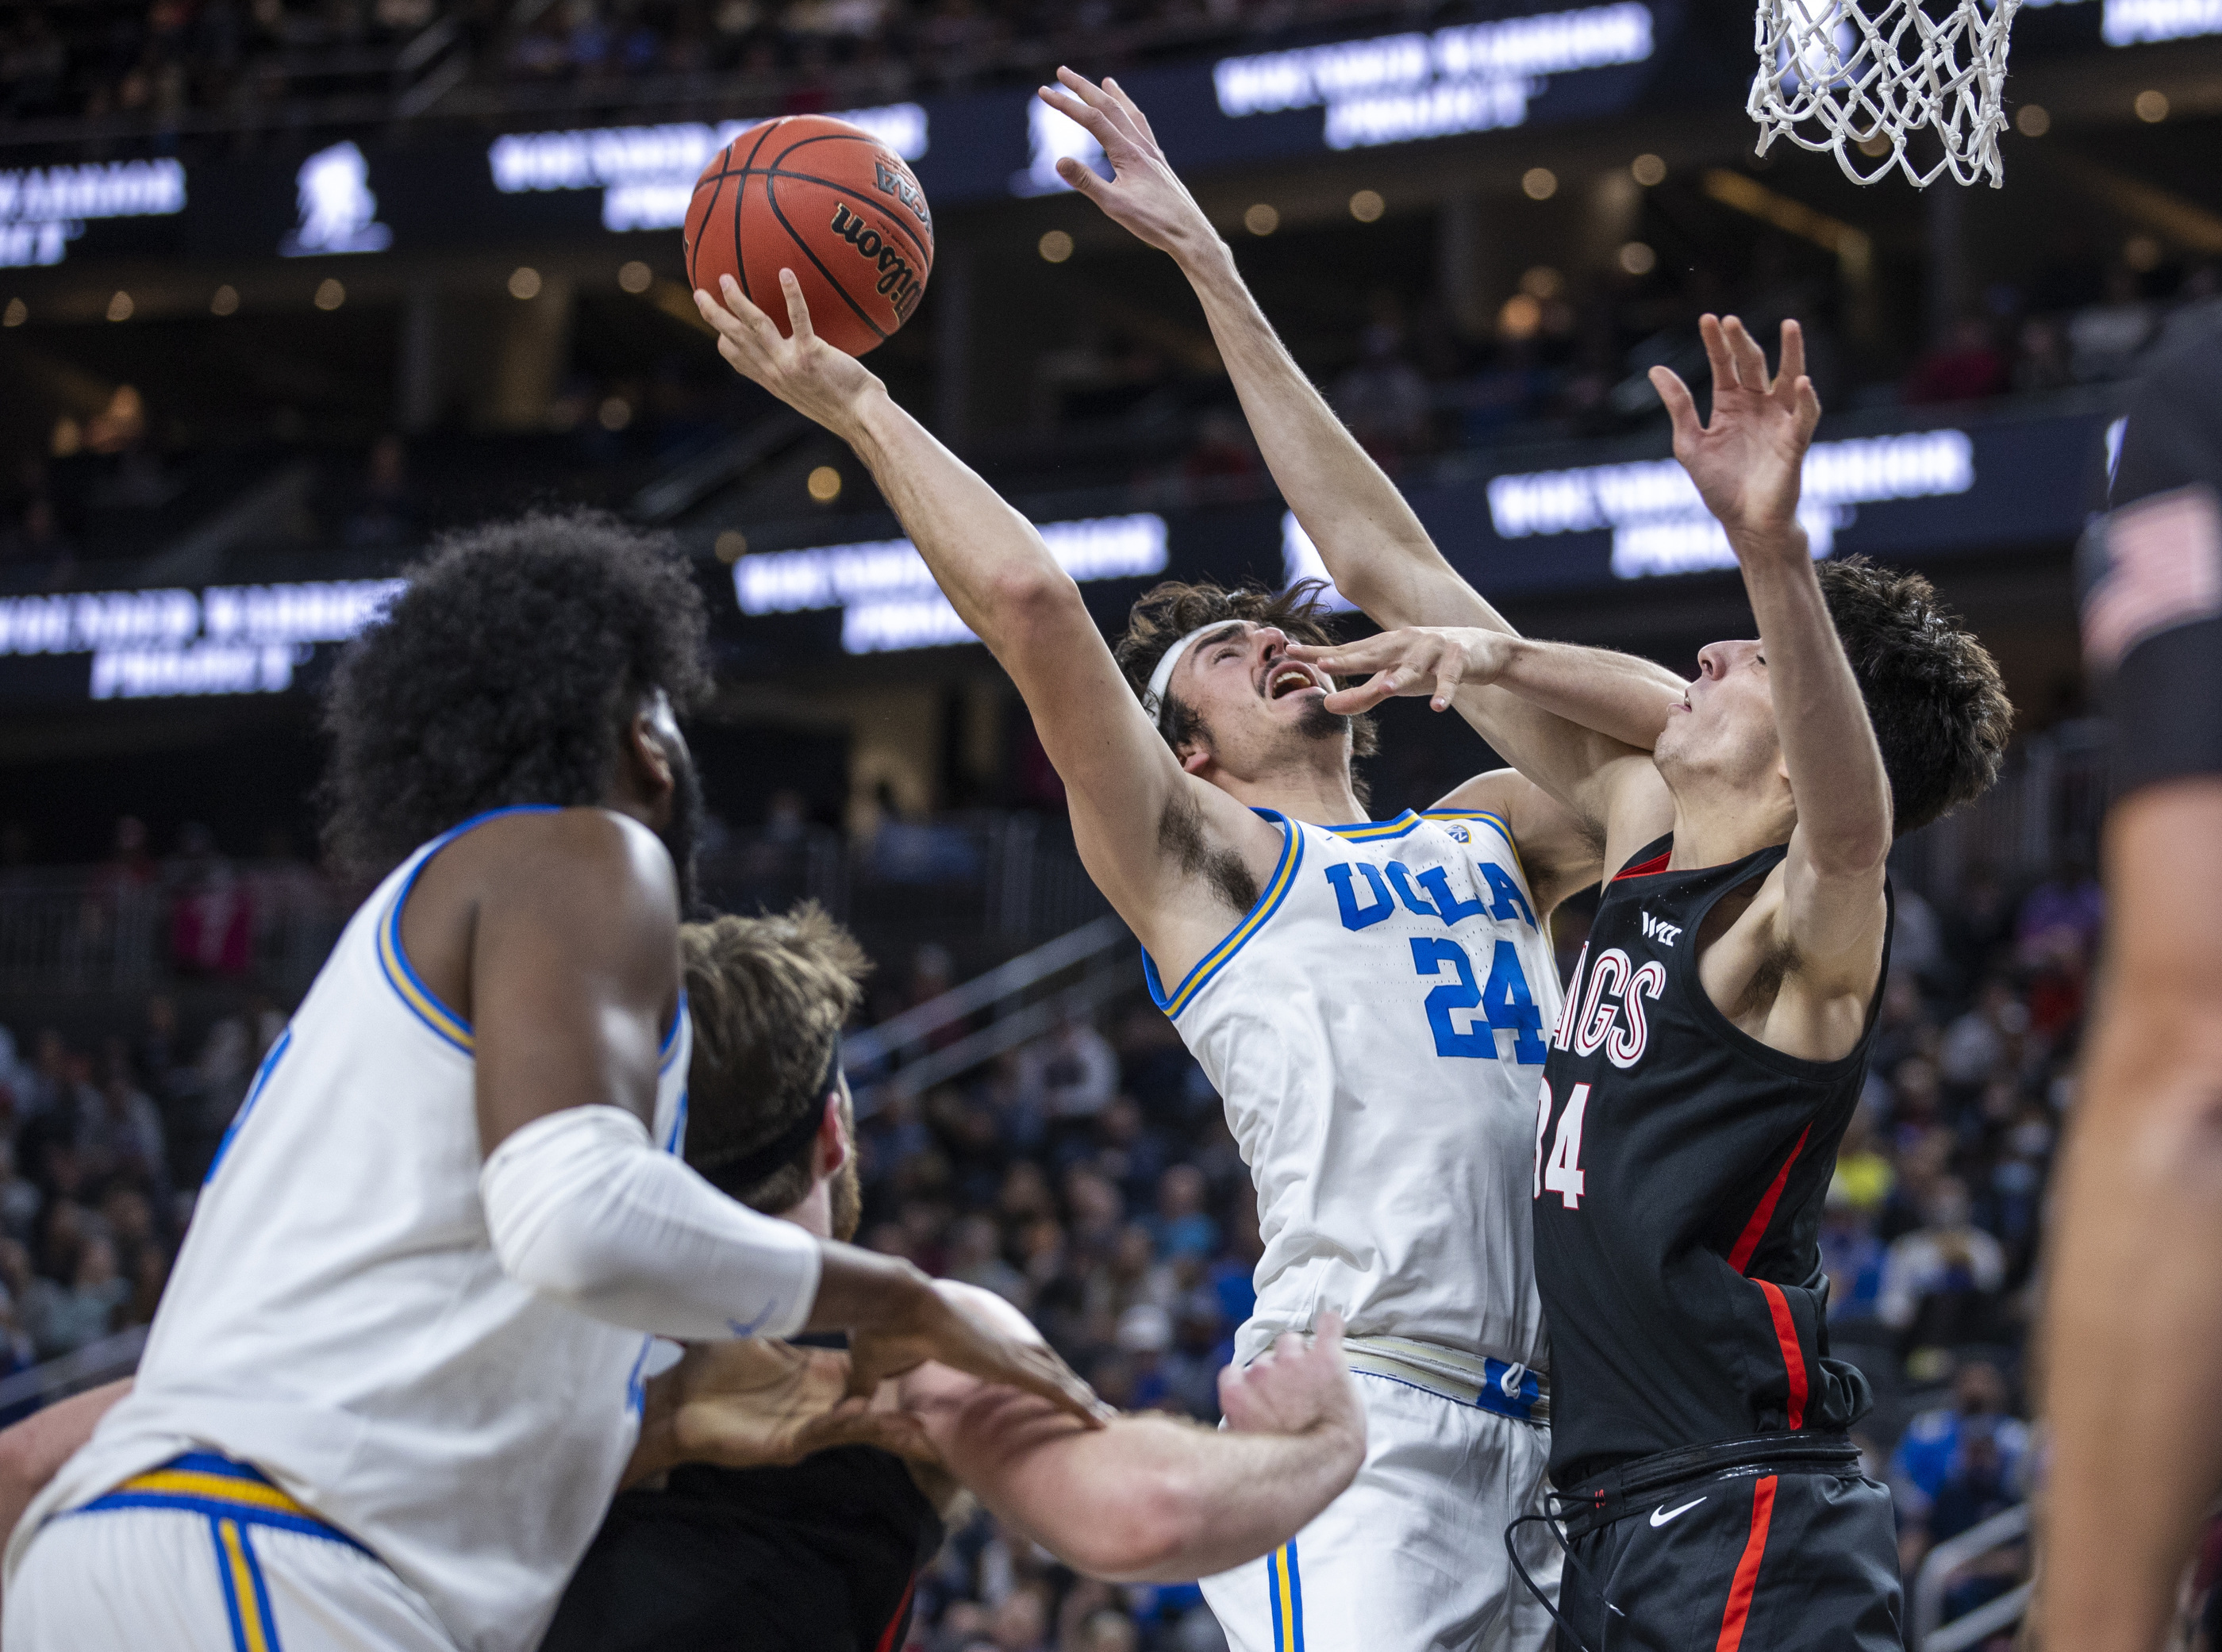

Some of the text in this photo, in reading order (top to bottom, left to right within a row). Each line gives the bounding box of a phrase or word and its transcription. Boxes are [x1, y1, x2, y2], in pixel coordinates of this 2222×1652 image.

[1324, 861, 1539, 935] UCLA
[1642, 911, 1682, 947] WCC
[1409, 937, 1547, 1065] 24
